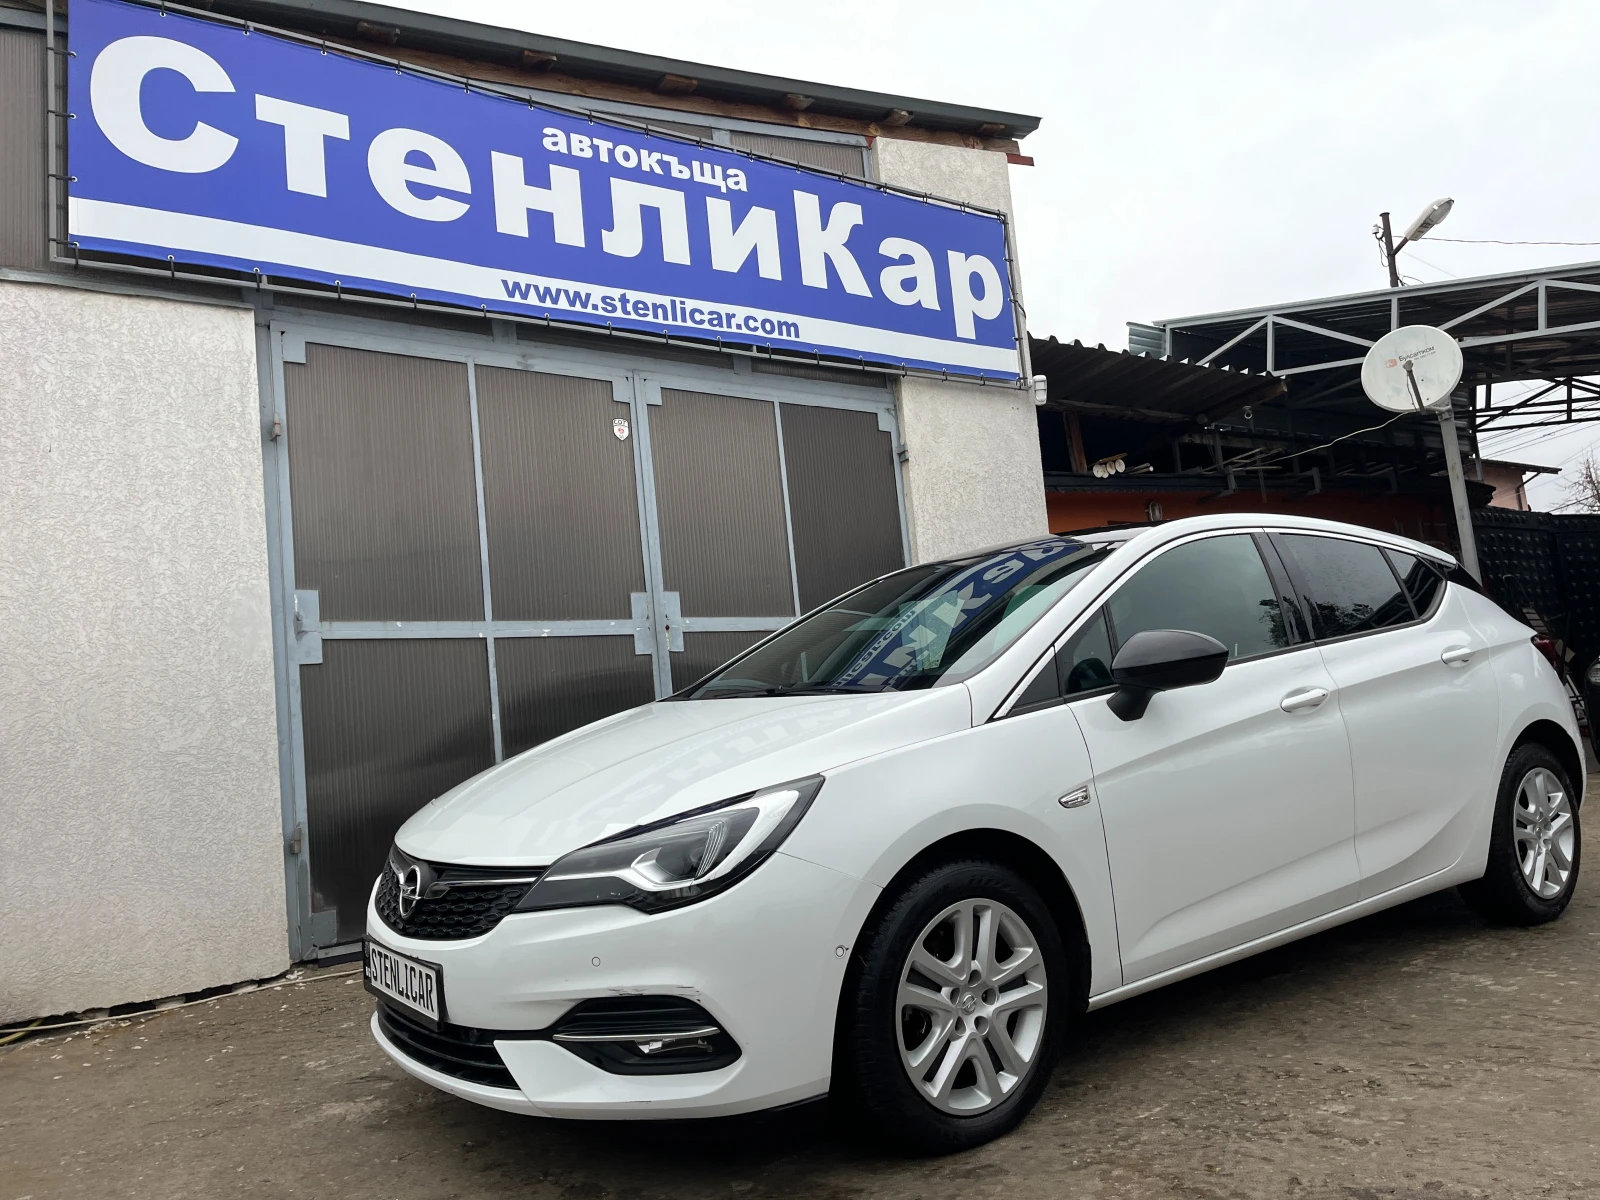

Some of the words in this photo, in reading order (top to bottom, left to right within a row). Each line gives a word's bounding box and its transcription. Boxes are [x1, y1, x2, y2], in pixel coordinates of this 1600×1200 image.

[90, 36, 1004, 340] СтенлиКар
[543, 127, 749, 194] автокъща
[502, 280, 800, 338] www.stenlicar.com
[371, 948, 435, 1013] STENLICAR
